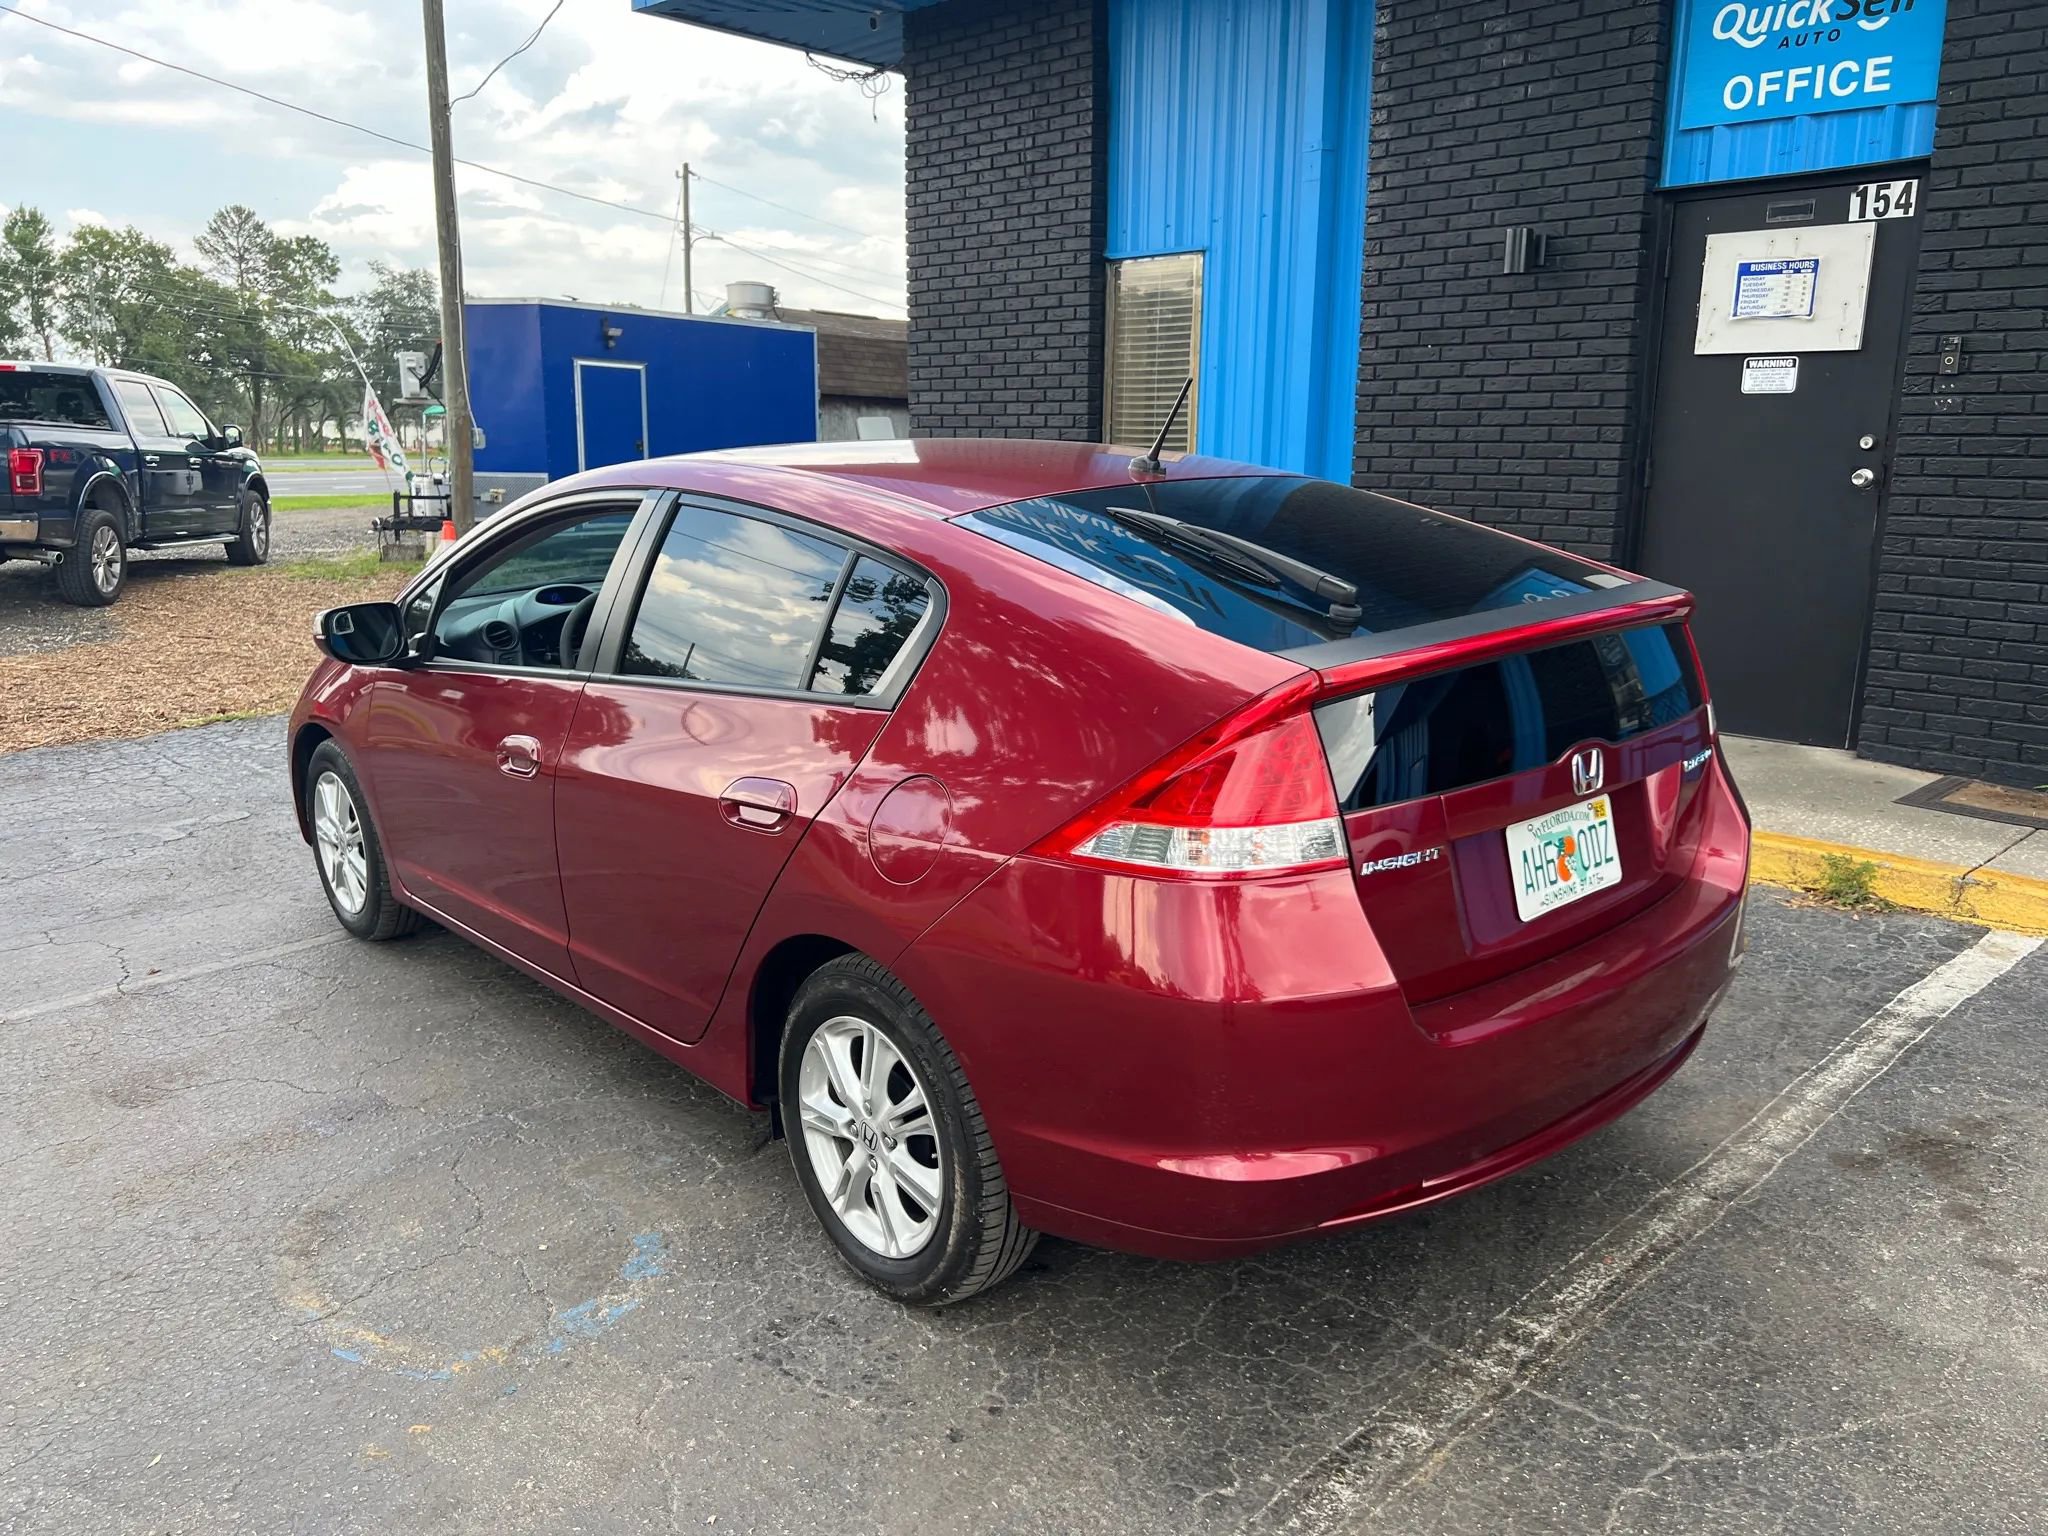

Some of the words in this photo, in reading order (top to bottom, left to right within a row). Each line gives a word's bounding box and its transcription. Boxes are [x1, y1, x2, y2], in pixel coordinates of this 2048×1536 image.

[1777, 28, 1841, 49] AUTO
[1723, 56, 1893, 111] OFFICE
[1855, 181, 1913, 219] 154
[1750, 263, 1787, 271] BUSINESS
[1788, 261, 1814, 269] HOURS
[1749, 360, 1793, 368] WARNING
[1360, 846, 1443, 875] INSIGHT
[1522, 840, 1558, 896] AH6
[1541, 881, 1578, 906] SUNSHINE
